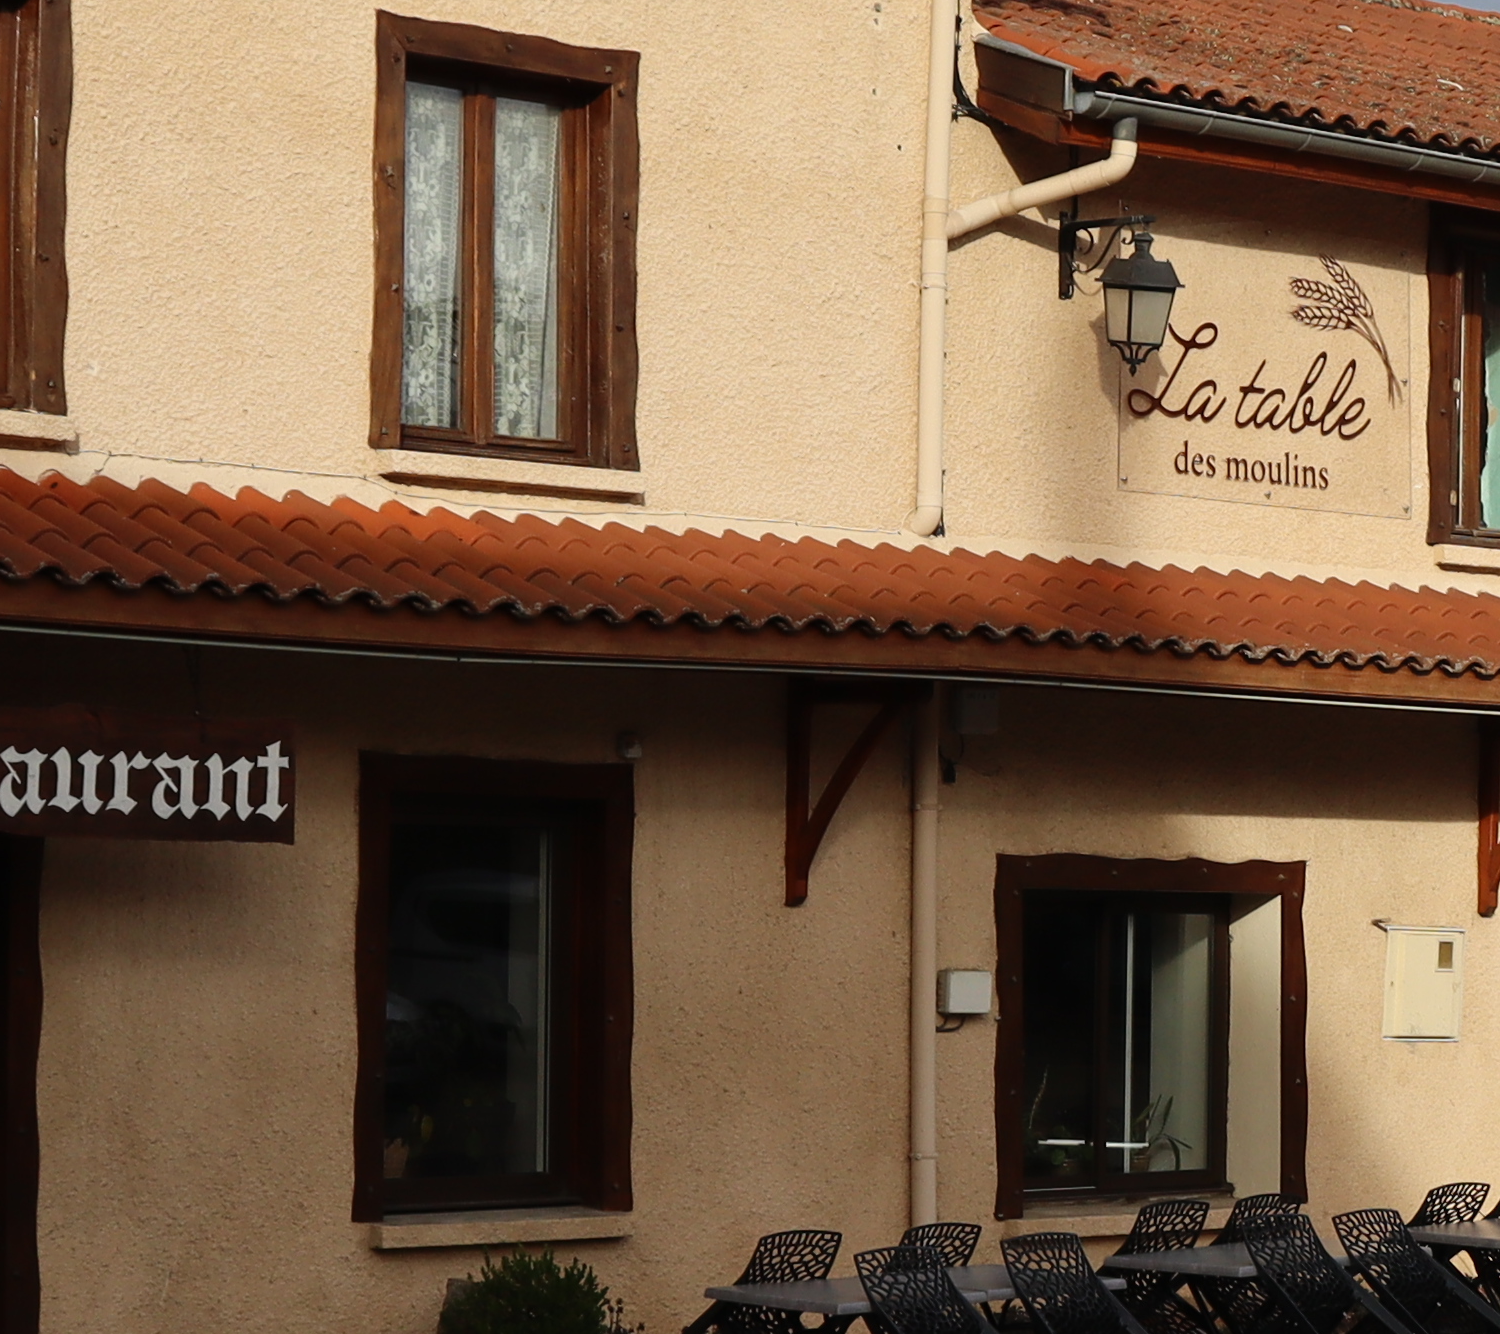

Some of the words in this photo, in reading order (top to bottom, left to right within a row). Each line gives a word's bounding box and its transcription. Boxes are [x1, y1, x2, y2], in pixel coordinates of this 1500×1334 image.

[1127, 322, 1227, 424] La
[1234, 351, 1372, 441] table
[1174, 440, 1216, 478] des
[1225, 451, 1329, 490] moulins
